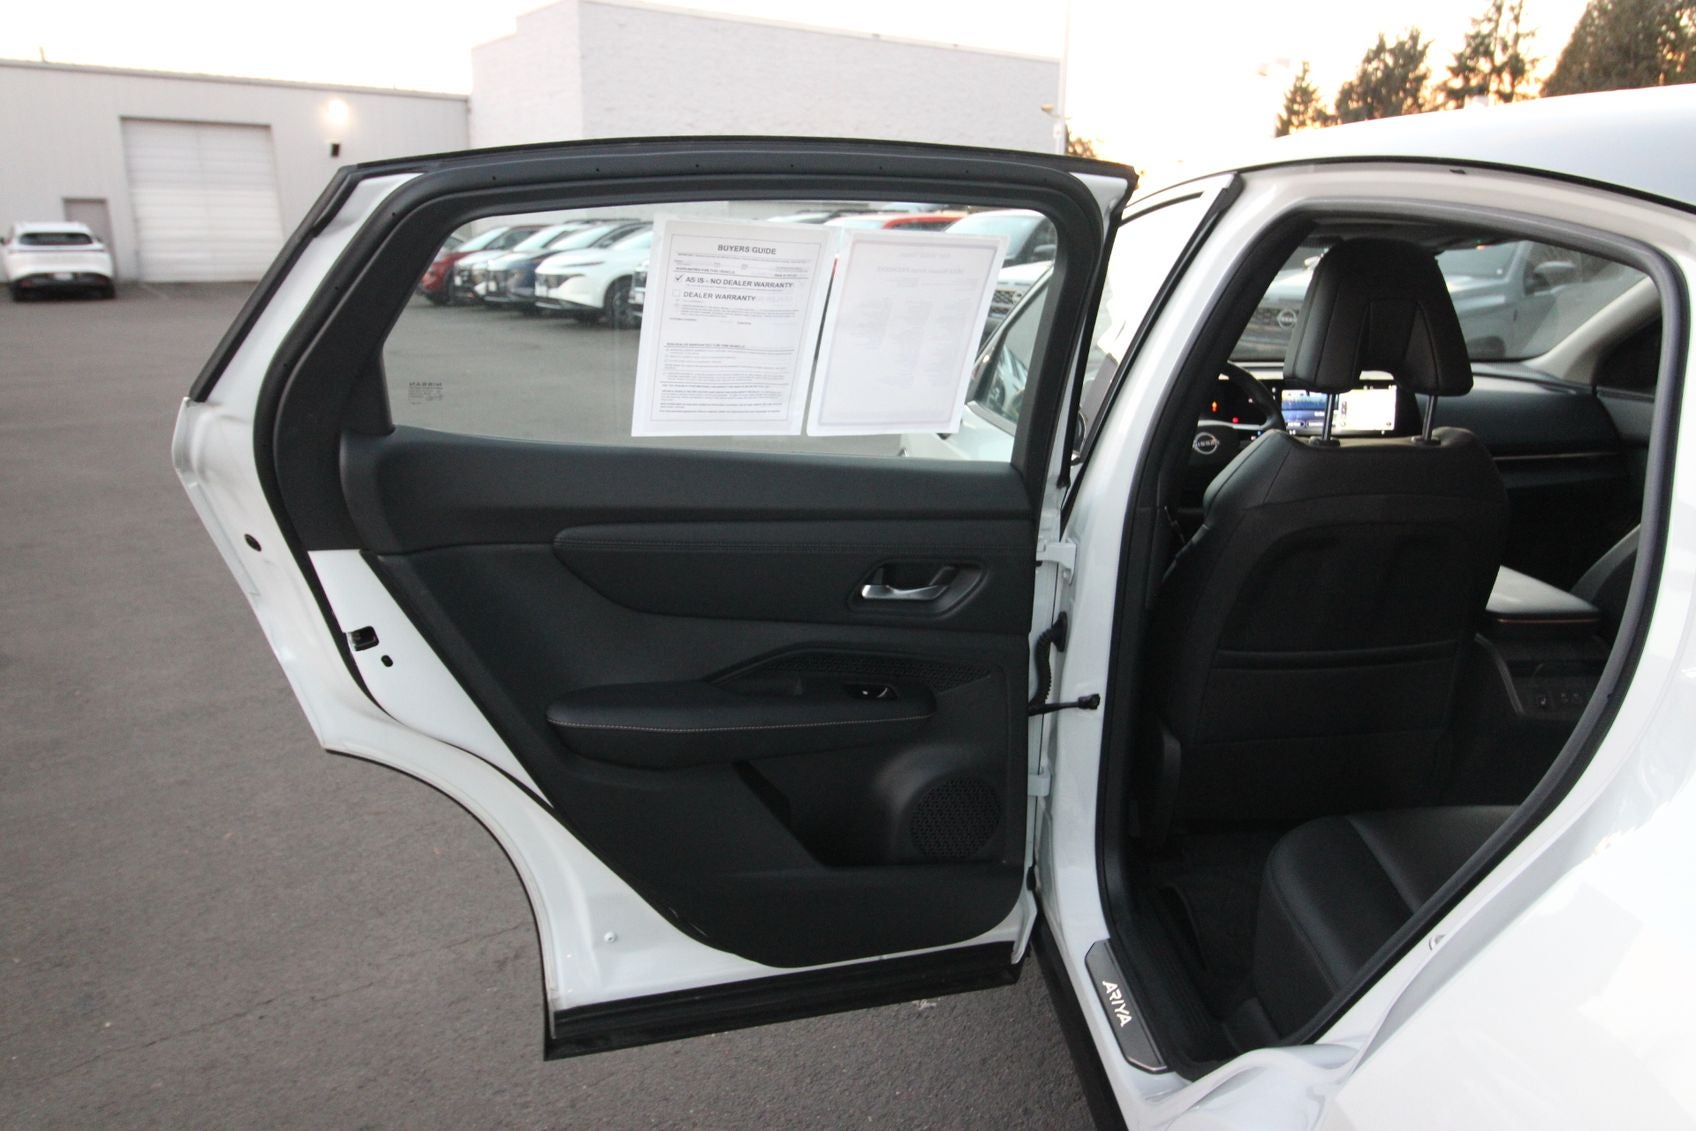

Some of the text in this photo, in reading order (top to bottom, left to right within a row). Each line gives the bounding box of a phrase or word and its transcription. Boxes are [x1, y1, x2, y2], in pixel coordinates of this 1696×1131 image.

[717, 244, 777, 255] BUYERS GUIDE
[723, 279, 752, 287] DEALER
[753, 281, 794, 289] WARRANTY
[683, 291, 756, 302] DEALER WARRANTY
[1101, 980, 1133, 1028] ARIYA
